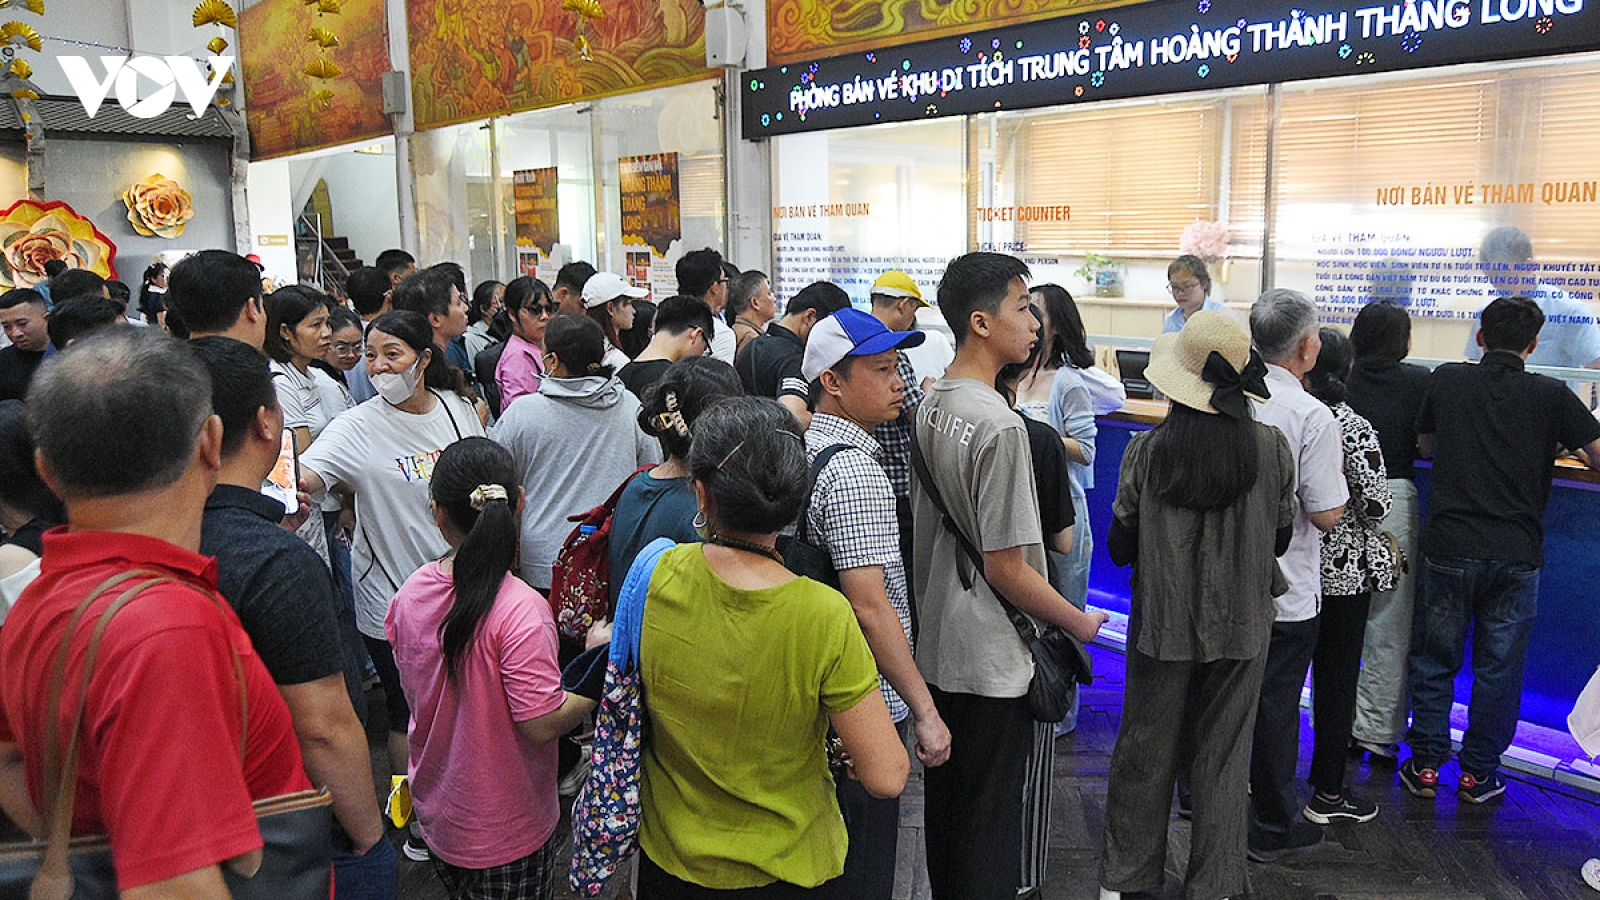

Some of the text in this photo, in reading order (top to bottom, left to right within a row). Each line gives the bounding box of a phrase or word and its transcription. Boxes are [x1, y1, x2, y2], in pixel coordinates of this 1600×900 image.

[789, 82, 840, 111] PHÒNG
[842, 75, 875, 105] BÁN
[876, 69, 899, 101] VÉ
[901, 70, 937, 97] KHU
[942, 66, 963, 92] DI
[967, 55, 1013, 88] TÍCH
[1018, 50, 1089, 82] TRUNG
[1095, 35, 1144, 71] TÂM
[1150, 24, 1241, 65] HOÀNG
[1247, 8, 1347, 52] THÀNH
[1376, 180, 1597, 206] NƠI BÁN VÉ THAM QUAN
[820, 203, 844, 217] THAM
[846, 202, 870, 217] QUAN
[976, 205, 1071, 222] TICKET COUNTER
[1348, 232, 1376, 243] THAM
[1543, 260, 1577, 272] KHUYẾT
[1567, 278, 1587, 287] CAO
[1568, 290, 1593, 300] CÔNG
